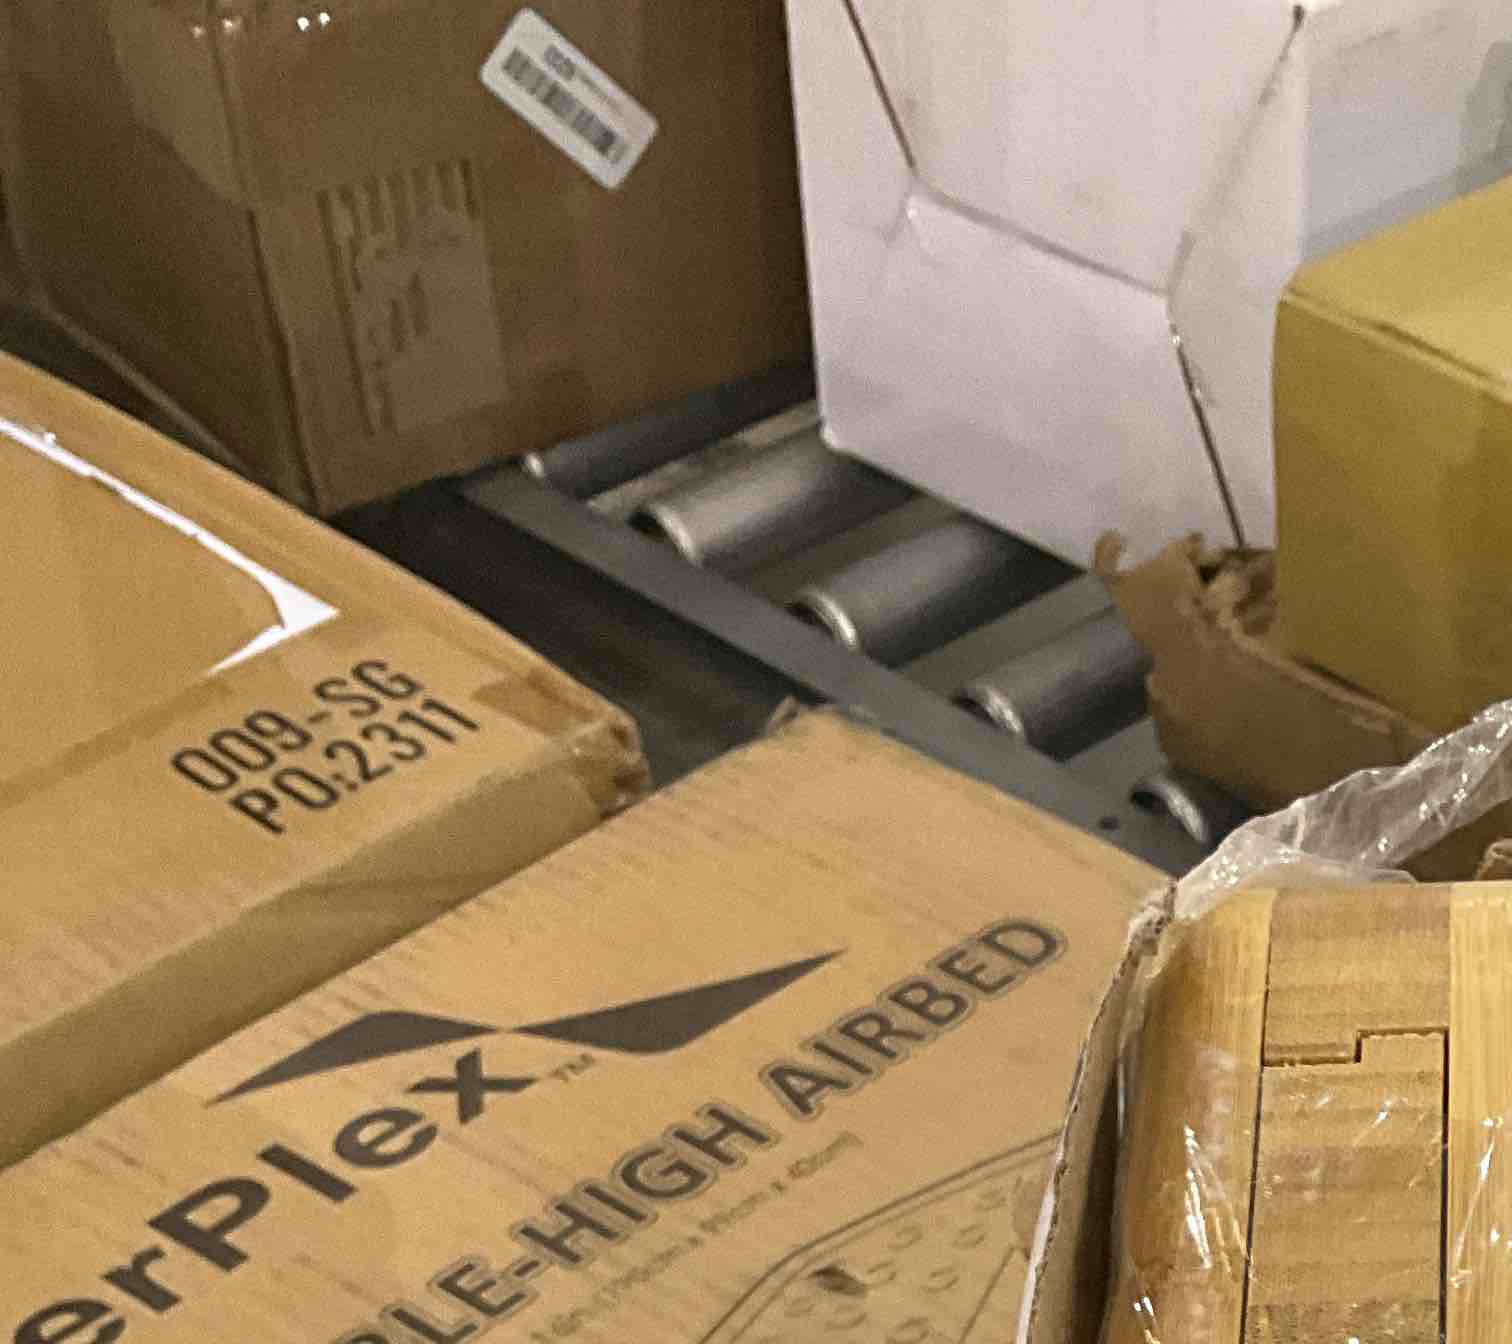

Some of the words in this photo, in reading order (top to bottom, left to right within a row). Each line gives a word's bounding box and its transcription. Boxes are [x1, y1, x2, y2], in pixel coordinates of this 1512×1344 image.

[173, 659, 424, 793] 009-SG
[230, 697, 480, 834] PO:2311
[766, 918, 1062, 1117] AIRBED
